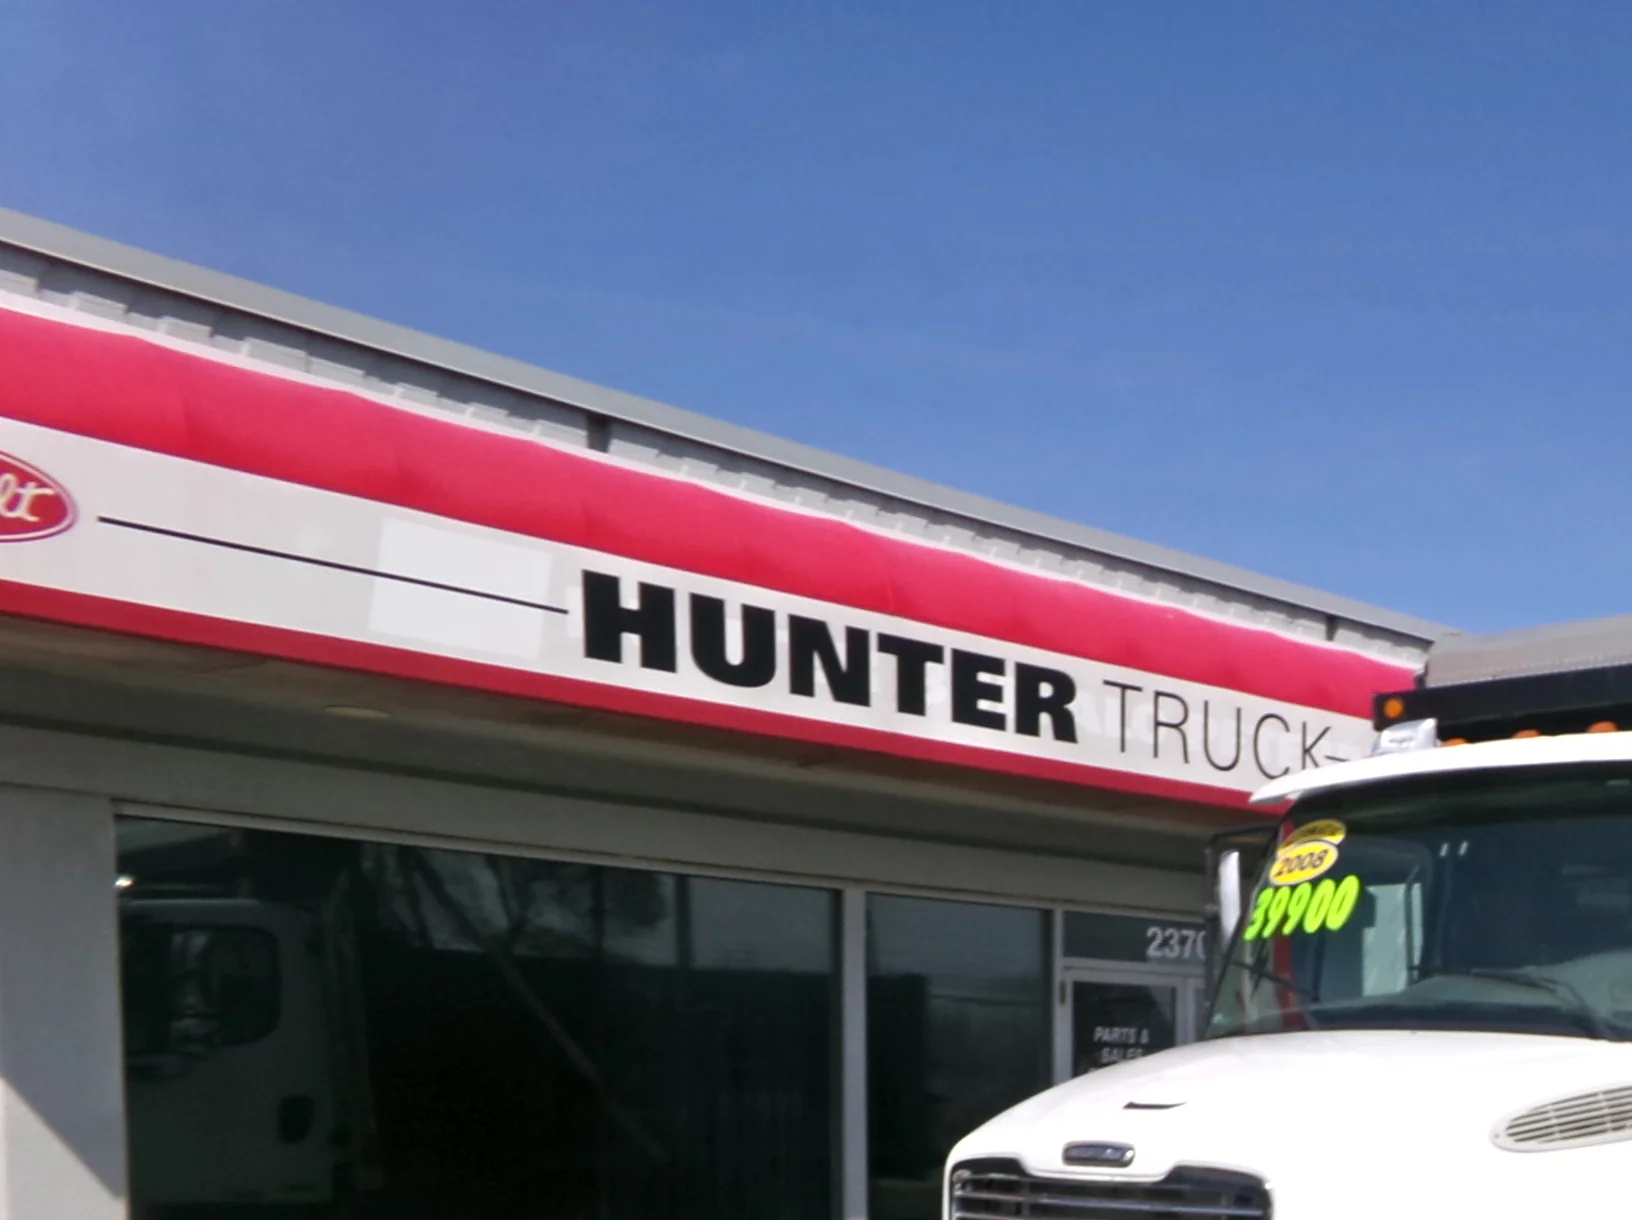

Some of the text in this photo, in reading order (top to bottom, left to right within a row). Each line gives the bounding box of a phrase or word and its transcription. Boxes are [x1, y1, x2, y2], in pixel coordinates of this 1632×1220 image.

[582, 579, 1332, 780] HUNTER TRUCK
[1274, 848, 1330, 877] 2008
[1243, 874, 1360, 940] 39900
[1094, 1026, 1136, 1044] PARTS
